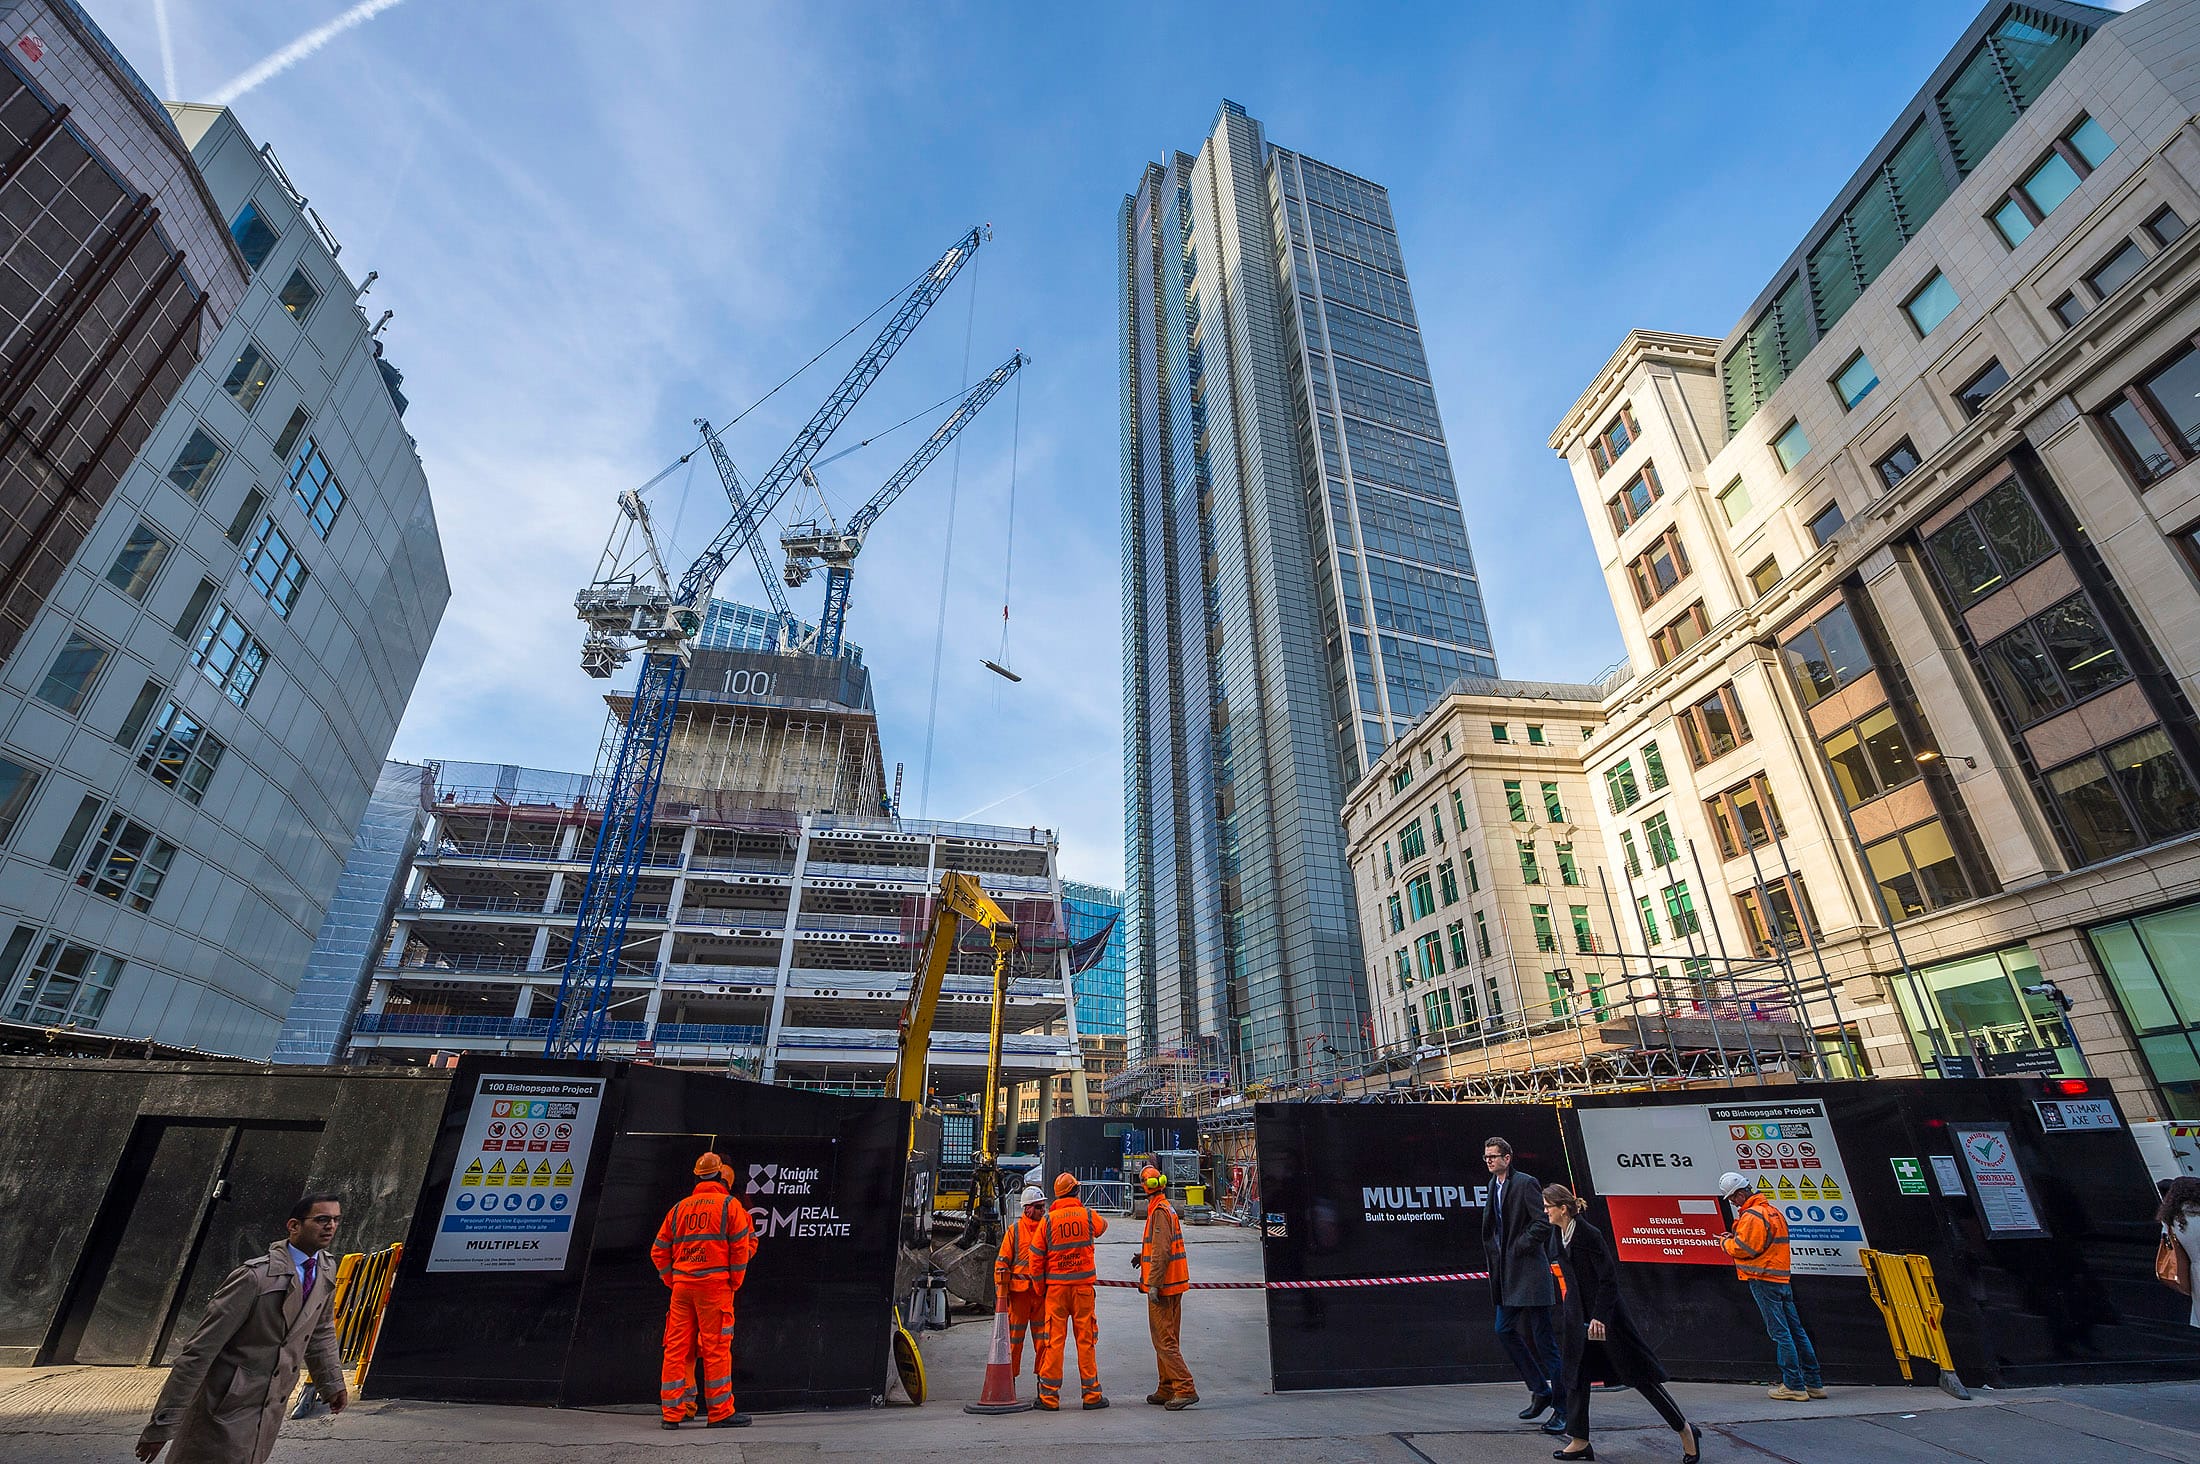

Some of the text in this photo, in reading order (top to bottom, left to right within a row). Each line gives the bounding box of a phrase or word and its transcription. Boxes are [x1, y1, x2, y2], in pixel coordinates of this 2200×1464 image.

[724, 669, 769, 696] 100
[489, 1083, 593, 1094] 100 Bishopsgate Project
[1716, 1107, 1815, 1118] 100 Bishopsgate Project
[2079, 1104, 2102, 1113] MARY
[2072, 1115, 2089, 1125] AXE
[2097, 1115, 2113, 1124] EC3
[1616, 1153, 1693, 1168] GATE 3a
[779, 1167, 820, 1183] Knight
[777, 1182, 811, 1194] Frank
[1362, 1186, 1489, 1209] MULTIPLE
[748, 1206, 840, 1238] GM REAL
[1365, 1212, 1445, 1222] Built to outperform.
[1649, 1217, 1684, 1225] BEWARE
[798, 1223, 851, 1237] ESTATE
[1633, 1227, 1706, 1236] MOVING VEHICLES
[466, 1240, 541, 1250] MULTIPLEX
[1621, 1237, 1720, 1247] AUTHORISED PERSONNE
[1663, 1248, 1684, 1256] ONLY
[1791, 1247, 1842, 1257] LTIPLEX
